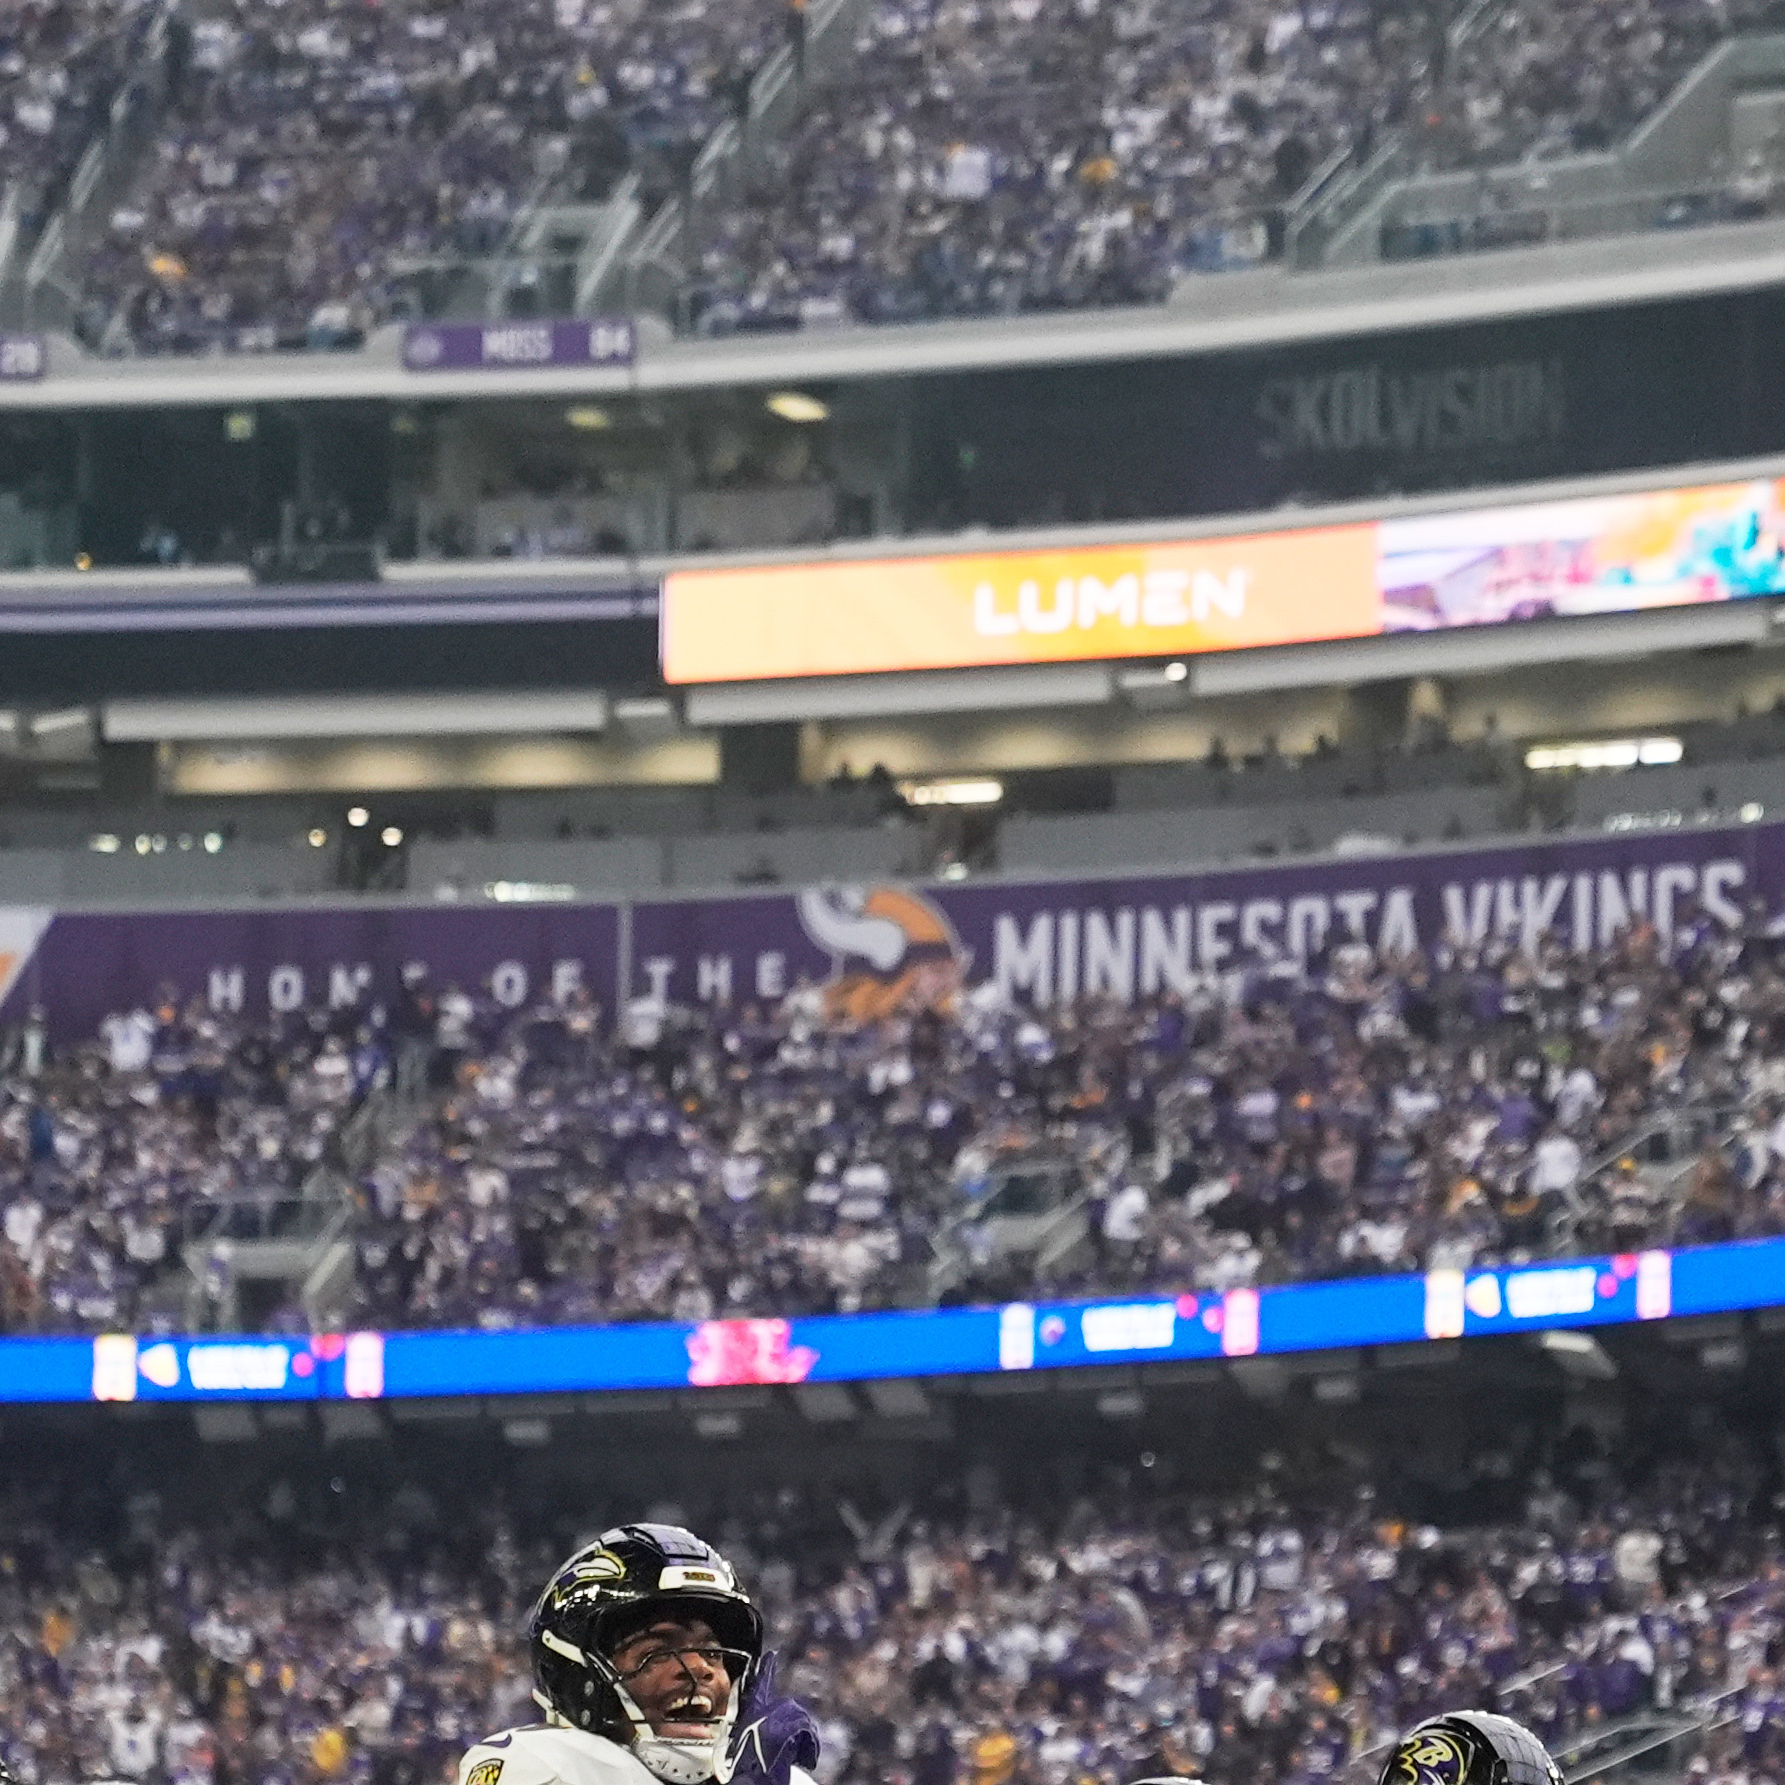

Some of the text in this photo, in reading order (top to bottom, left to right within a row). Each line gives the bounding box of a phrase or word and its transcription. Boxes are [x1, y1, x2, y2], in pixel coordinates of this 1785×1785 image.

[973, 568, 1247, 637] LUMEN
[493, 957, 585, 1004] OF
[643, 950, 789, 1000] THE
[992, 888, 1415, 1002] MINNESOTA
